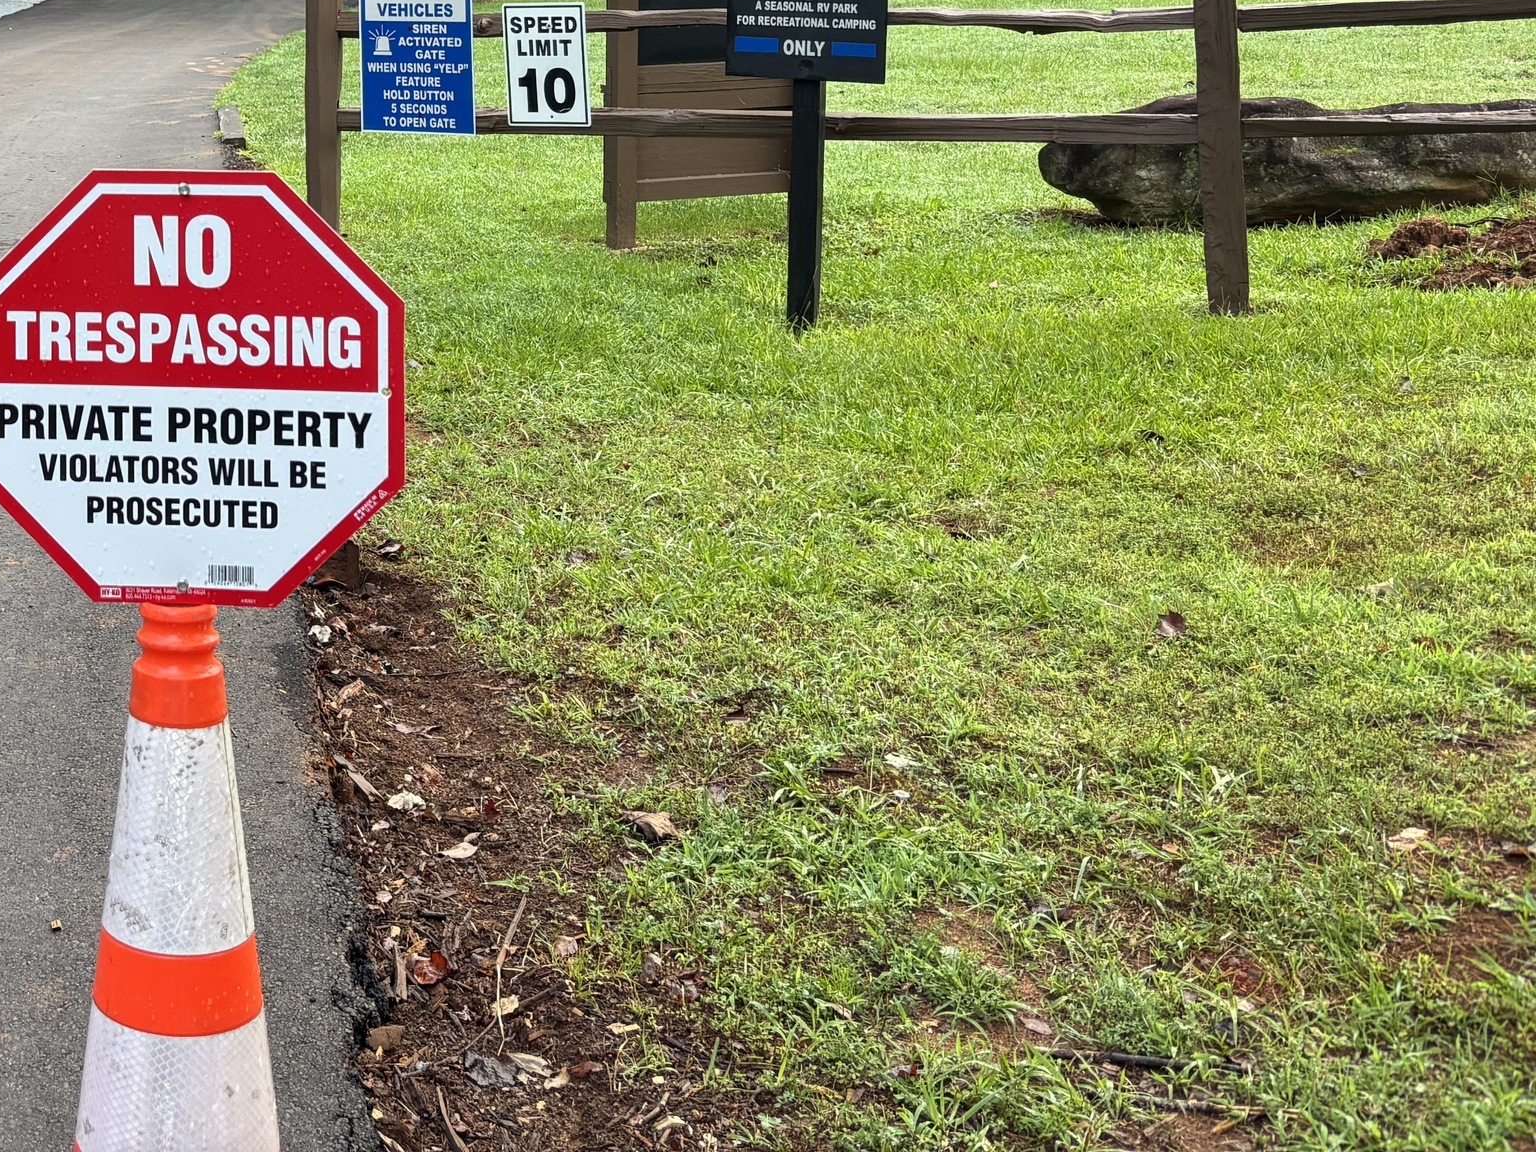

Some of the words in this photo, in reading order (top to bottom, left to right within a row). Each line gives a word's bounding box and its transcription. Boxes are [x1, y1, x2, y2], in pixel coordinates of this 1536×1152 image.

[377, 3, 453, 18] VEHICLES
[755, 0, 762, 11] A
[764, 0, 814, 12] SEASONAL
[817, 2, 830, 13] RV
[832, 3, 858, 14] PARK
[412, 24, 447, 34] SIREN
[510, 16, 577, 34] SPEED
[736, 15, 755, 26] FOR
[757, 16, 829, 29] RECREATIONAL
[832, 19, 876, 30] CAMPING
[398, 37, 462, 47] ACTIVATED
[517, 39, 572, 56] LIMIT
[783, 39, 825, 57] ONLY
[415, 49, 446, 60] GATE
[367, 62, 397, 73] WHEN
[400, 62, 431, 73] USING
[395, 76, 441, 87] FEATURE
[383, 90, 411, 100] HOLD
[414, 90, 454, 101] BUTTON
[518, 67, 576, 113] 10
[391, 103, 397, 114] 5
[400, 103, 447, 115] SECONDS
[383, 116, 396, 127] TO
[399, 117, 427, 128] OPEN
[430, 118, 456, 129] GATE
[133, 213, 231, 289] NO
[6, 310, 361, 369] TRESPASSING
[167, 406, 372, 449] PROPERTY
[39, 453, 198, 485] VIOLATORS
[208, 457, 279, 488] WILL
[289, 461, 326, 489] BE
[86, 496, 279, 529] PROSECUTED
[101, 588, 121, 596] HY-KO
